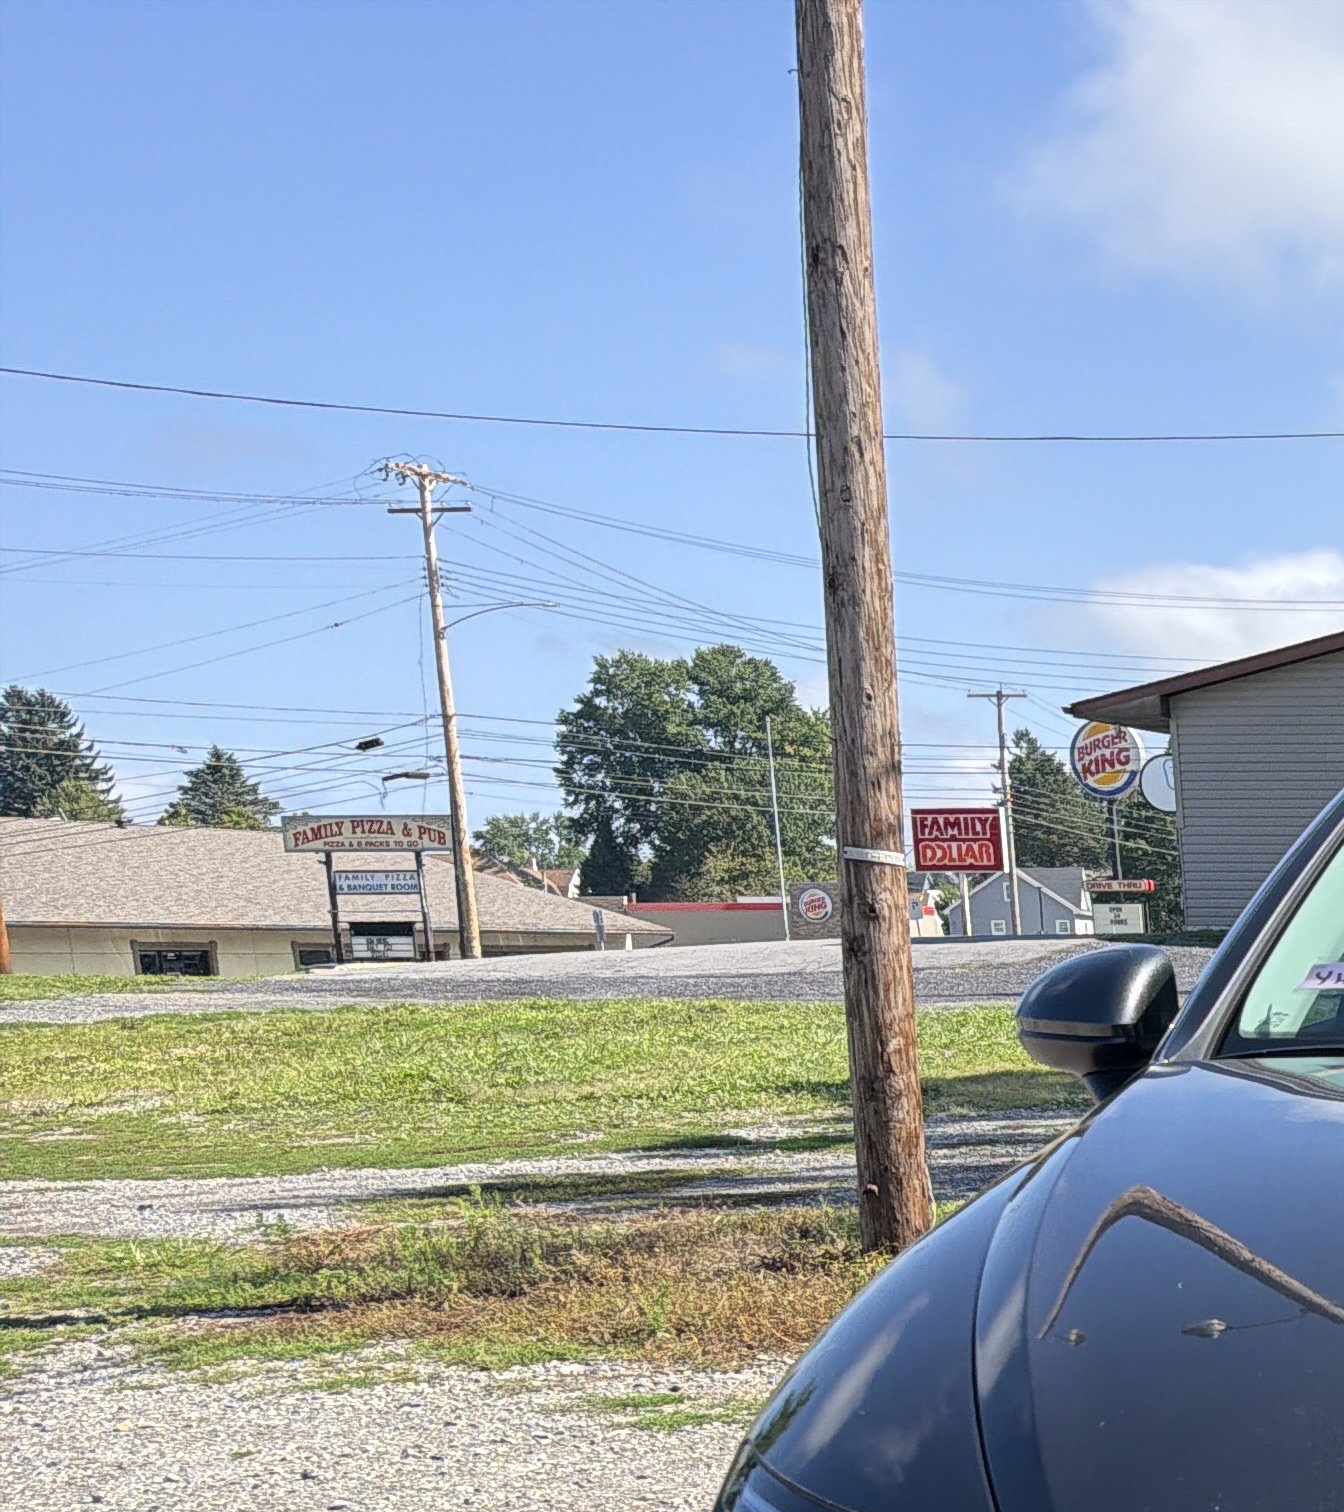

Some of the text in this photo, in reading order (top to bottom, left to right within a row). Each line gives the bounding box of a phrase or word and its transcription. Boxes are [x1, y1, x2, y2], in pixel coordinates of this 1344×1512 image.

[1077, 730, 1128, 762] BURGER
[1081, 747, 1131, 781] KING
[293, 819, 447, 848] FAMILY PIZZA & PUB
[917, 814, 992, 838] FAMILY
[323, 840, 346, 848] PIZZA
[364, 840, 391, 848] PACKS
[393, 840, 404, 848] TO
[406, 840, 420, 848] GO
[919, 841, 995, 865] DOLLAR
[338, 873, 416, 882] FAMILY PIZZA
[1086, 881, 1142, 890] DRIVE THRU
[346, 883, 389, 892] BANQUET
[390, 882, 419, 891] ROOM
[805, 901, 828, 914] KING
